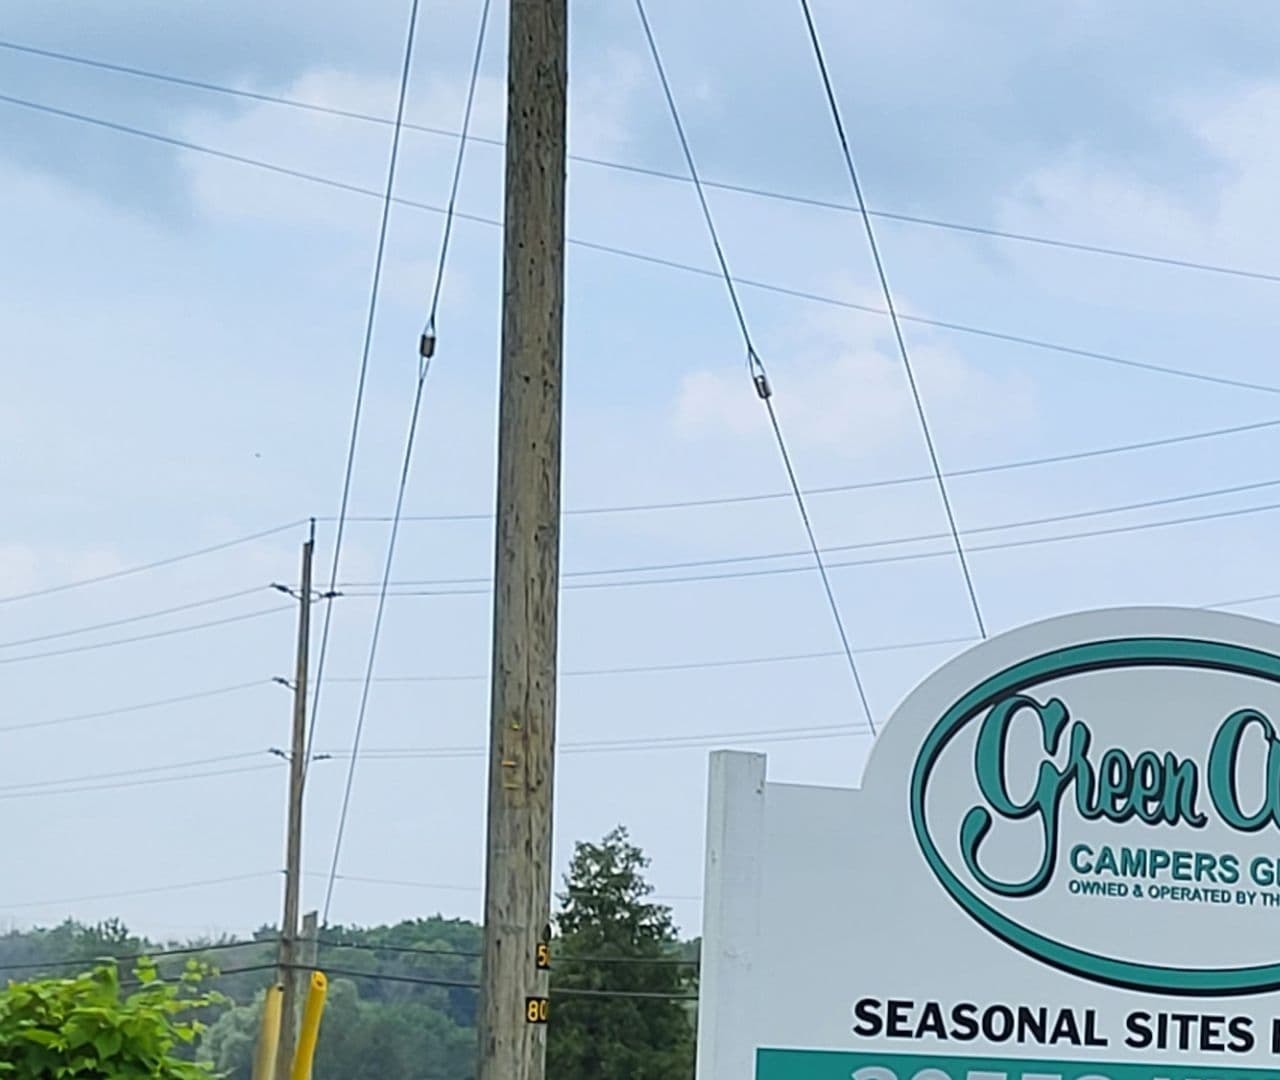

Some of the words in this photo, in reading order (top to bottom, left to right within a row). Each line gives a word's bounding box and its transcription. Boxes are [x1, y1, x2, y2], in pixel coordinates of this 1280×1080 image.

[960, 695, 1207, 897] Green
[1069, 843, 1240, 885] CAMPERS
[1068, 879, 1129, 897] OWNED
[1133, 884, 1144, 898] &
[1149, 884, 1232, 904] OPERATED
[1236, 890, 1257, 905] BY
[853, 998, 1109, 1047] SEASONAL
[1124, 1011, 1255, 1053] SITES
